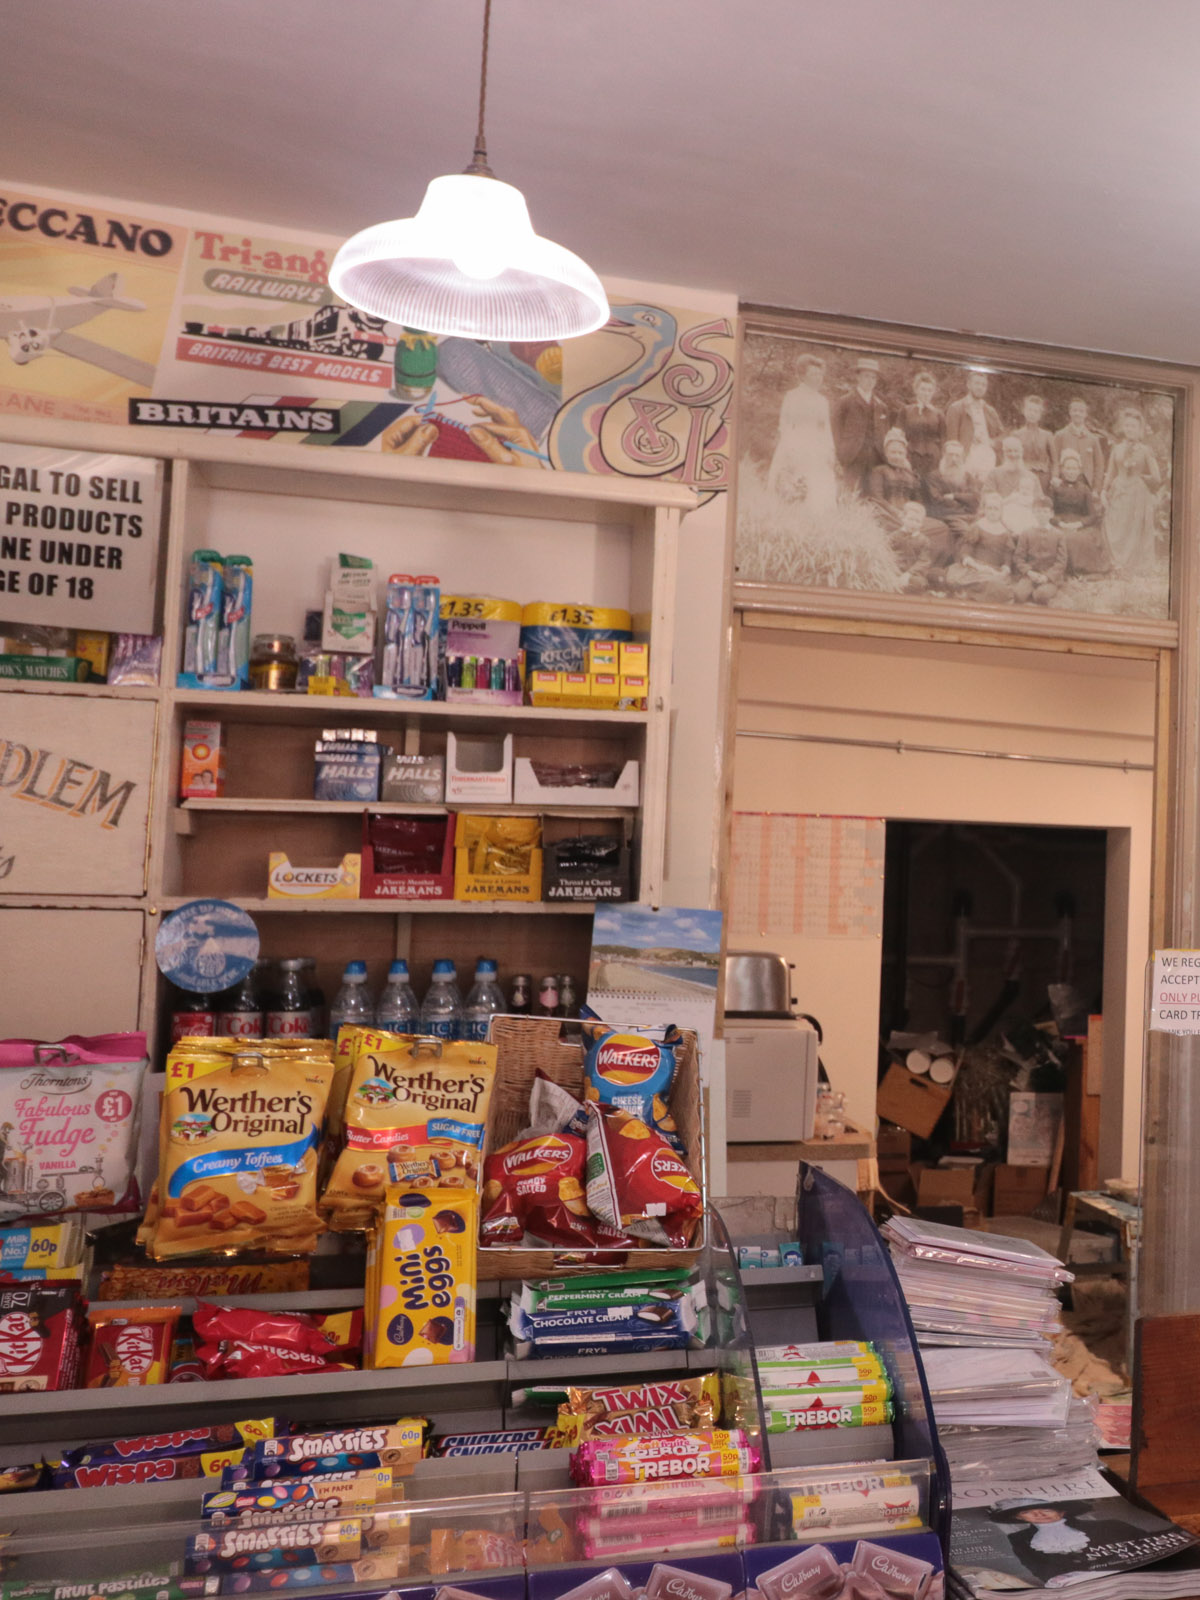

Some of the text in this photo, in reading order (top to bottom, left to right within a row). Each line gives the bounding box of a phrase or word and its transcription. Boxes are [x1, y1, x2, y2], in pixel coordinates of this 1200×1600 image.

[194, 231, 328, 284] Tri-ang
[211, 273, 325, 303] RAILWAYS
[188, 343, 383, 385] BRITAINS BEST MODELS
[137, 402, 334, 432] BRITAINS
[49, 471, 81, 497] TO
[89, 476, 143, 505] SELL
[5, 501, 143, 538] PRODUCTS
[1, 536, 123, 570] NE UNDER
[28, 573, 59, 596] OF
[65, 577, 94, 600] 18
[550, 609, 595, 626] £1.35
[319, 764, 377, 779] HALLS
[388, 767, 441, 782] HALLS
[274, 871, 338, 883] LOCKETS
[374, 885, 443, 896] JAKEMANS
[464, 885, 530, 894] JAKEMANS
[548, 886, 622, 897] JAKEMANS
[1161, 957, 1178, 968] WE
[1160, 974, 1200, 985] ACCEPT
[1160, 992, 1188, 1003] ONLY
[1159, 1009, 1188, 1020] CARD
[364, 1033, 383, 1050] £1
[598, 1049, 659, 1069] WALKERS
[170, 1061, 195, 1079] £1
[368, 1055, 485, 1094] Werther's
[20, 1071, 90, 1090] Thorntons
[14, 1095, 91, 1119] Fabulous
[102, 1096, 124, 1116] £1
[180, 1086, 312, 1114] Werther's
[392, 1087, 479, 1114] Original
[211, 1112, 306, 1138] Original
[431, 1123, 481, 1138] SUGAR FREE
[19, 1117, 96, 1157] Fudge
[346, 1130, 409, 1145] Butter Candies
[39, 1159, 77, 1171] VANILLA
[193, 1151, 284, 1175] Creamy Toffees
[505, 1148, 570, 1169] WALKERS
[516, 1184, 547, 1196] SALTED
[6, 1235, 28, 1244] Milk
[597, 1227, 628, 1239] SALTED
[4, 1246, 27, 1257] No.1
[31, 1239, 57, 1256] 60p
[393, 1252, 430, 1310] Mini
[423, 1244, 455, 1309] eggs
[11, 1291, 29, 1309] 70
[548, 1291, 606, 1301] PEPPERMINT
[533, 1315, 595, 1328] CHOCOLATE
[566, 1309, 597, 1317] FRY'S
[393, 1315, 407, 1344] Cadbury
[0, 1314, 41, 1367] KitKat
[117, 1331, 153, 1373] KitKat
[858, 1367, 872, 1375] 50p
[592, 1382, 687, 1411] TWIX
[863, 1394, 877, 1402] 50p
[863, 1405, 877, 1413] 50p
[594, 1406, 690, 1437] TWIX
[782, 1409, 852, 1428] TREBOR
[114, 1427, 211, 1457] Wispa
[401, 1430, 420, 1441] 60p
[440, 1430, 539, 1448] SNICKERS
[637, 1439, 691, 1449] soft fruits
[714, 1432, 729, 1440] 50p
[288, 1429, 388, 1462] SMARTIES
[621, 1445, 700, 1458] TREBOR
[722, 1452, 738, 1461] 50p
[75, 1459, 176, 1488] Wispa
[630, 1456, 711, 1480] TREBOR
[331, 1484, 353, 1494] PAPER
[221, 1523, 325, 1558] SMARTIES
[1088, 1540, 1135, 1552] MEET
[1085, 1546, 1128, 1560] NEW
[781, 1565, 821, 1592] Cadbury
[872, 1555, 912, 1585] Cadbury
